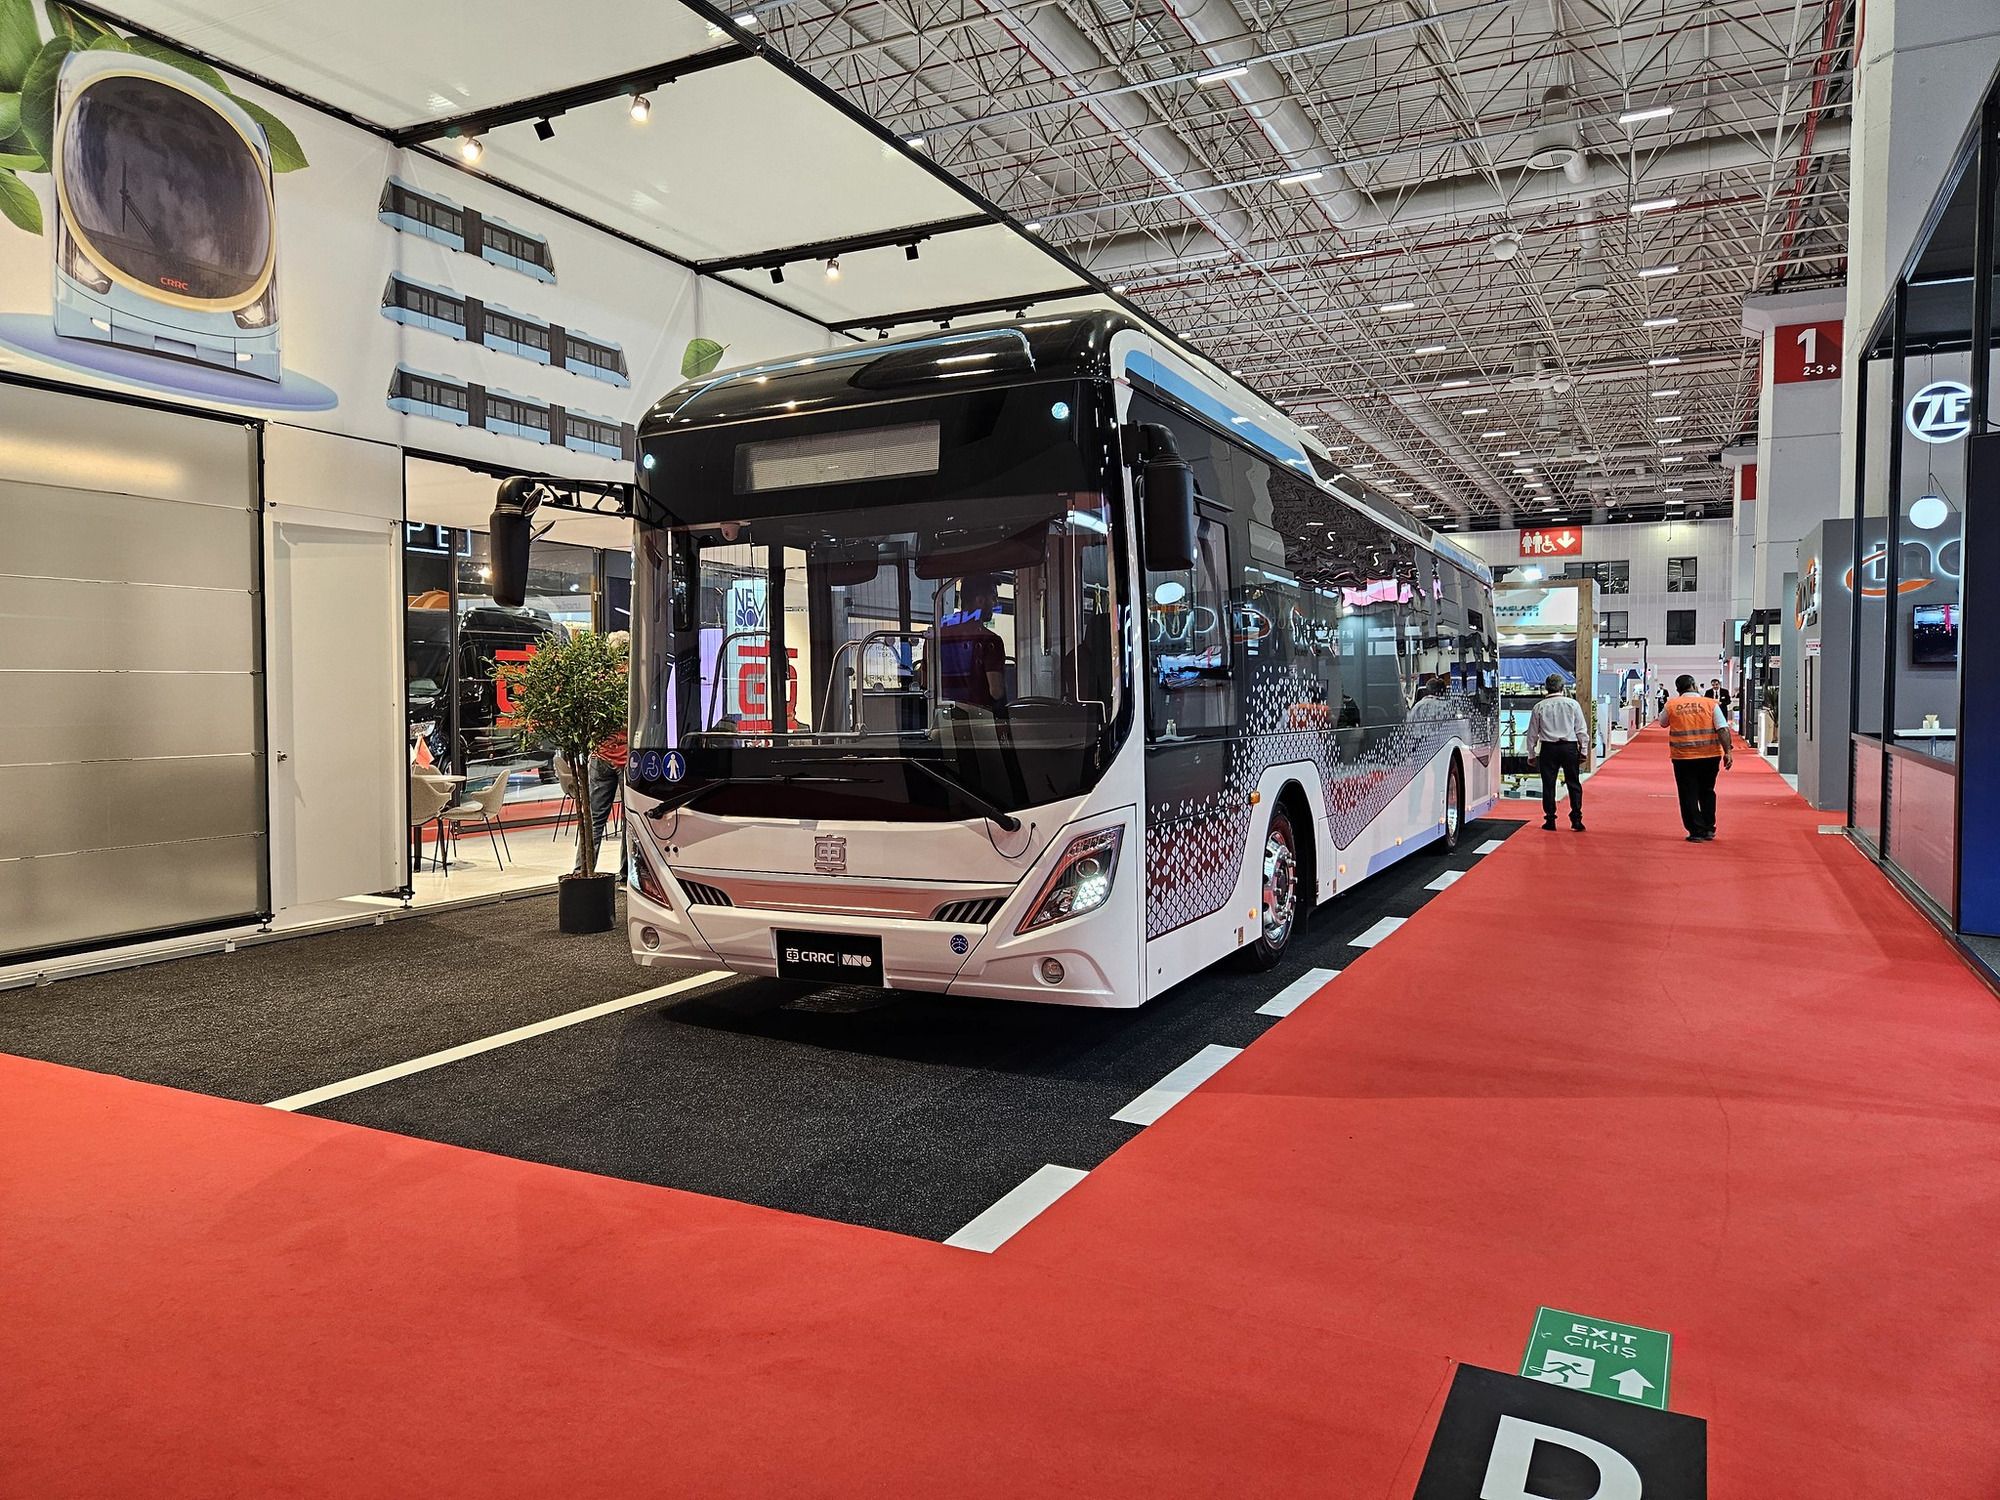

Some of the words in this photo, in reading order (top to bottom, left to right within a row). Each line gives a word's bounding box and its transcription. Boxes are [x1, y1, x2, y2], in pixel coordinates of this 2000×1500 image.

[160, 277, 189, 290] CRRC
[1797, 328, 1817, 364] 1
[1803, 365, 1823, 376] 2-3
[801, 951, 835, 964] CRRC
[1571, 1323, 1638, 1345] EXIT
[1563, 1335, 1637, 1359] ÇIKIŞ
